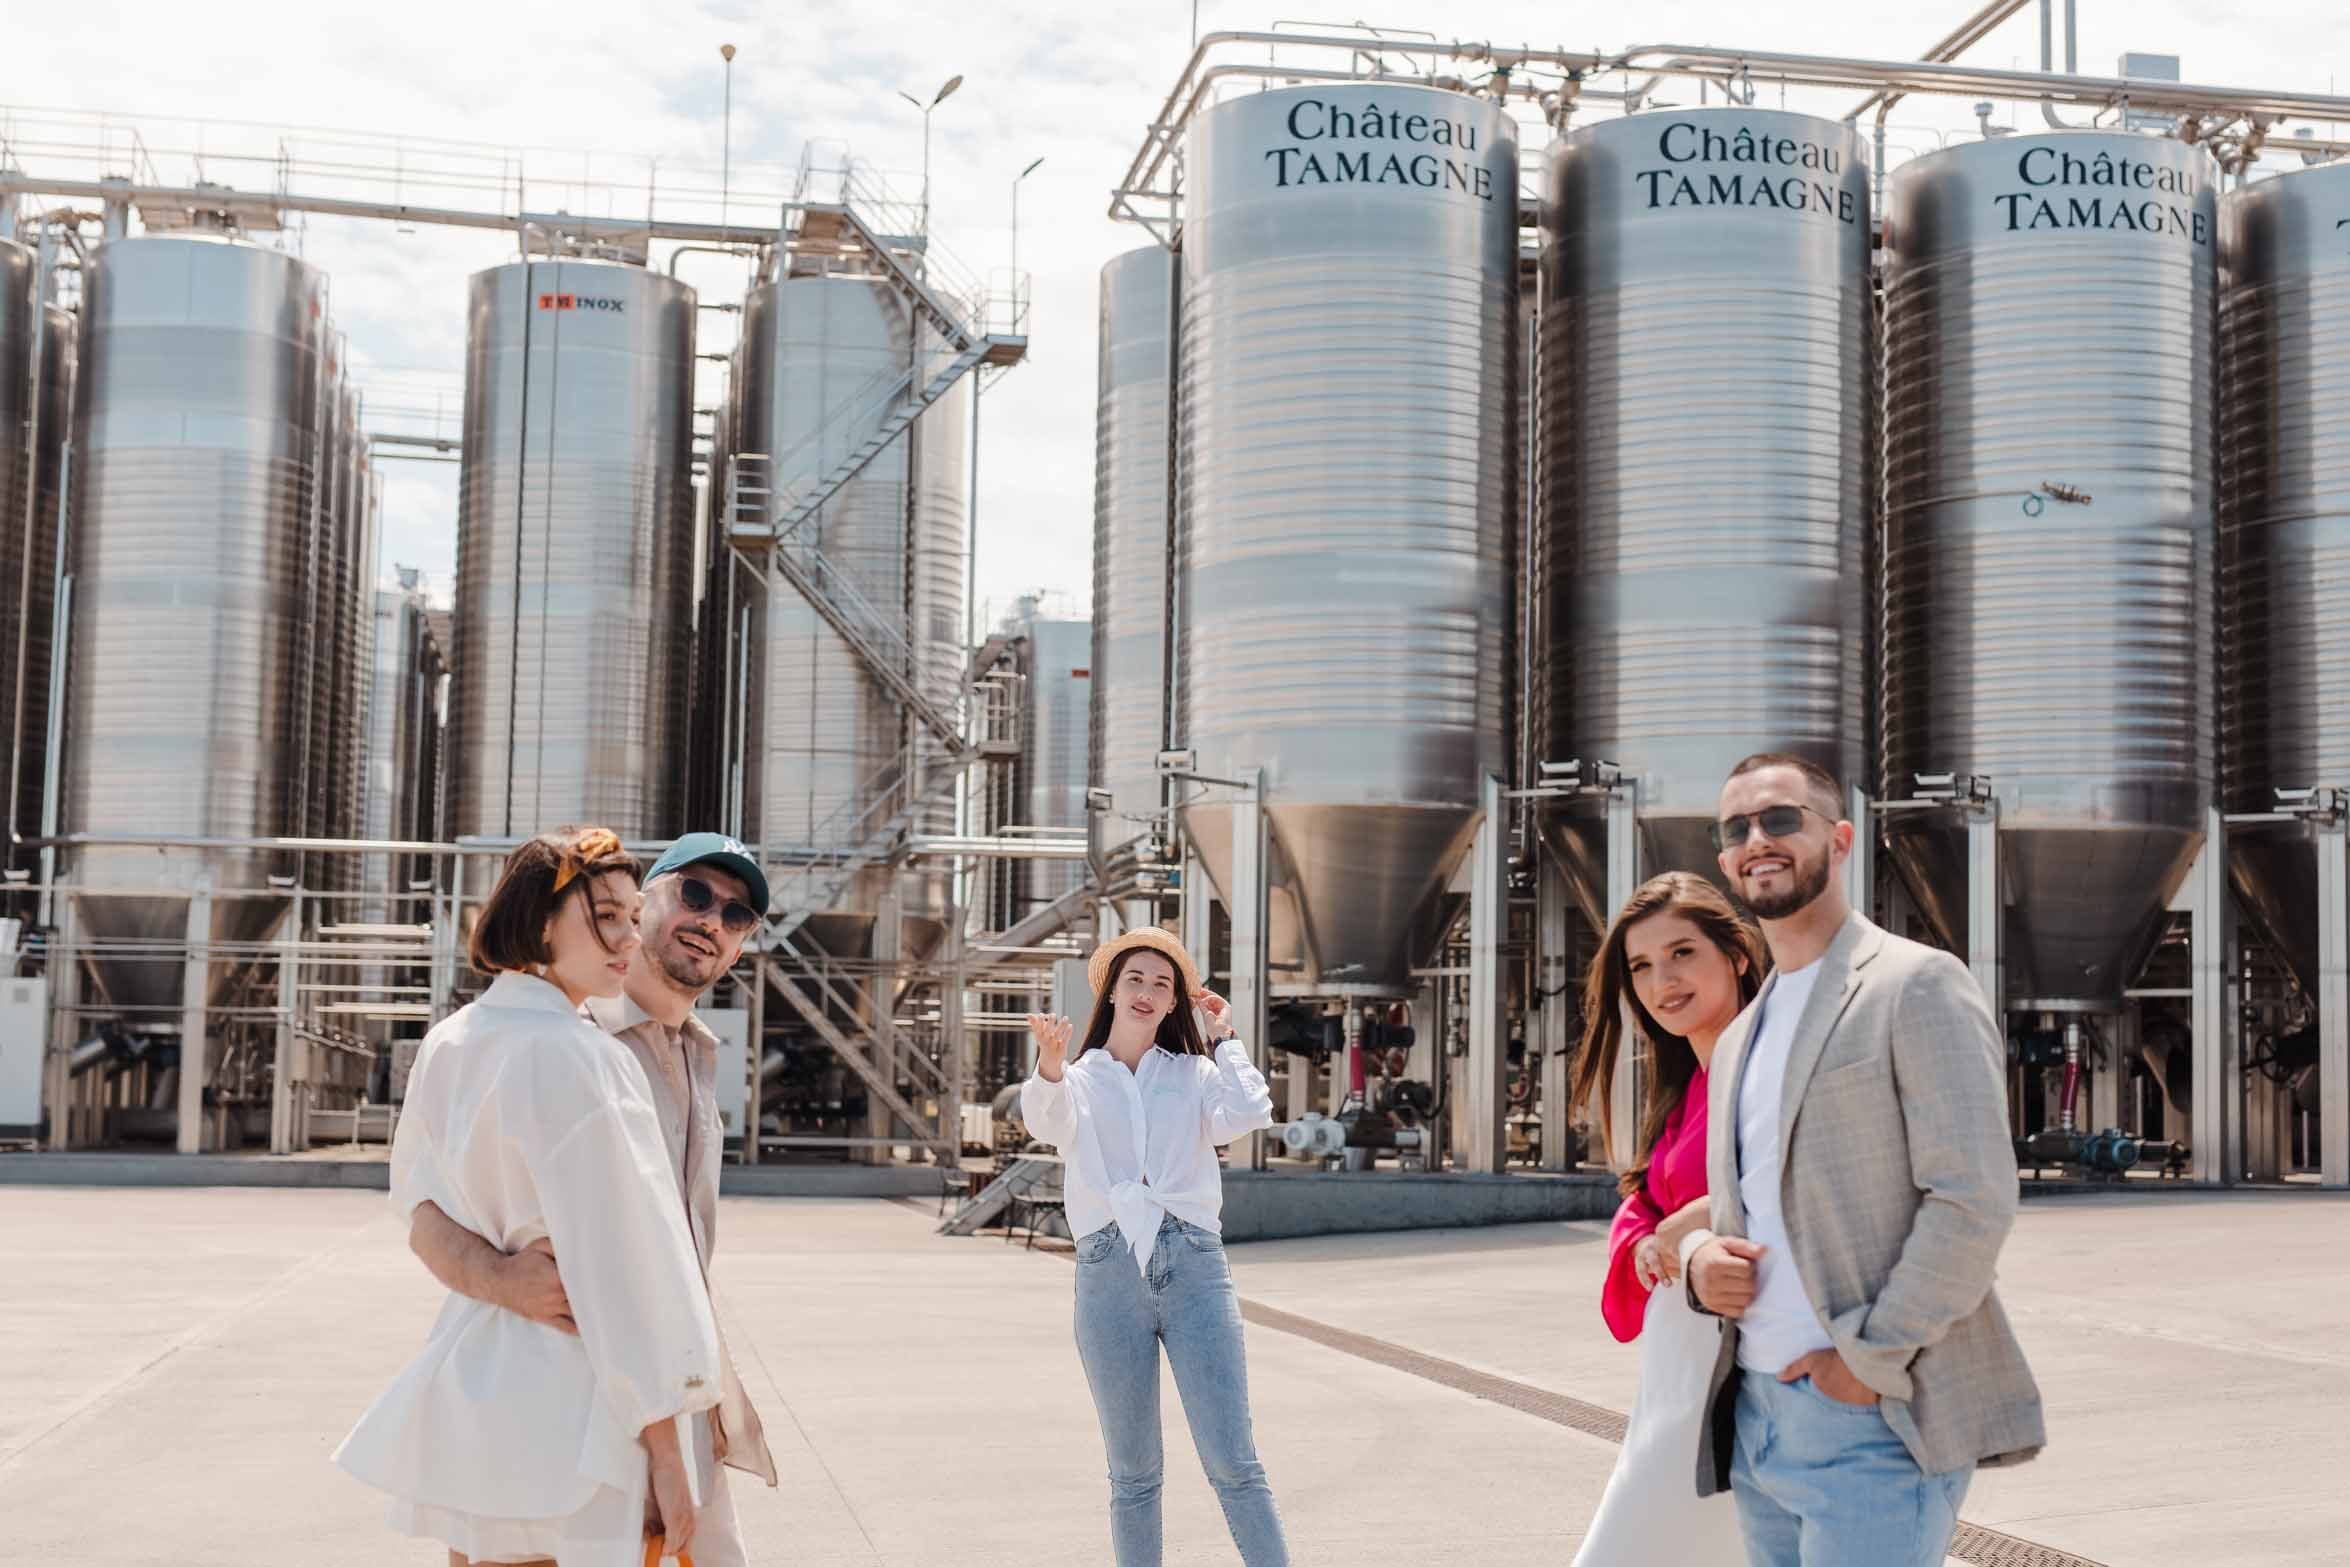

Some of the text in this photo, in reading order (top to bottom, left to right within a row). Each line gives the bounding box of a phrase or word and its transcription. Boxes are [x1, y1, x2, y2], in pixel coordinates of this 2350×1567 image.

[1287, 100, 1476, 151] Château
[1659, 123, 1840, 175] Château
[1265, 147, 1494, 201] TAMAGNE
[1635, 169, 1855, 225] TAMAGNE
[2018, 147, 2195, 197] Château
[1994, 193, 2207, 245] TAMAGNE
